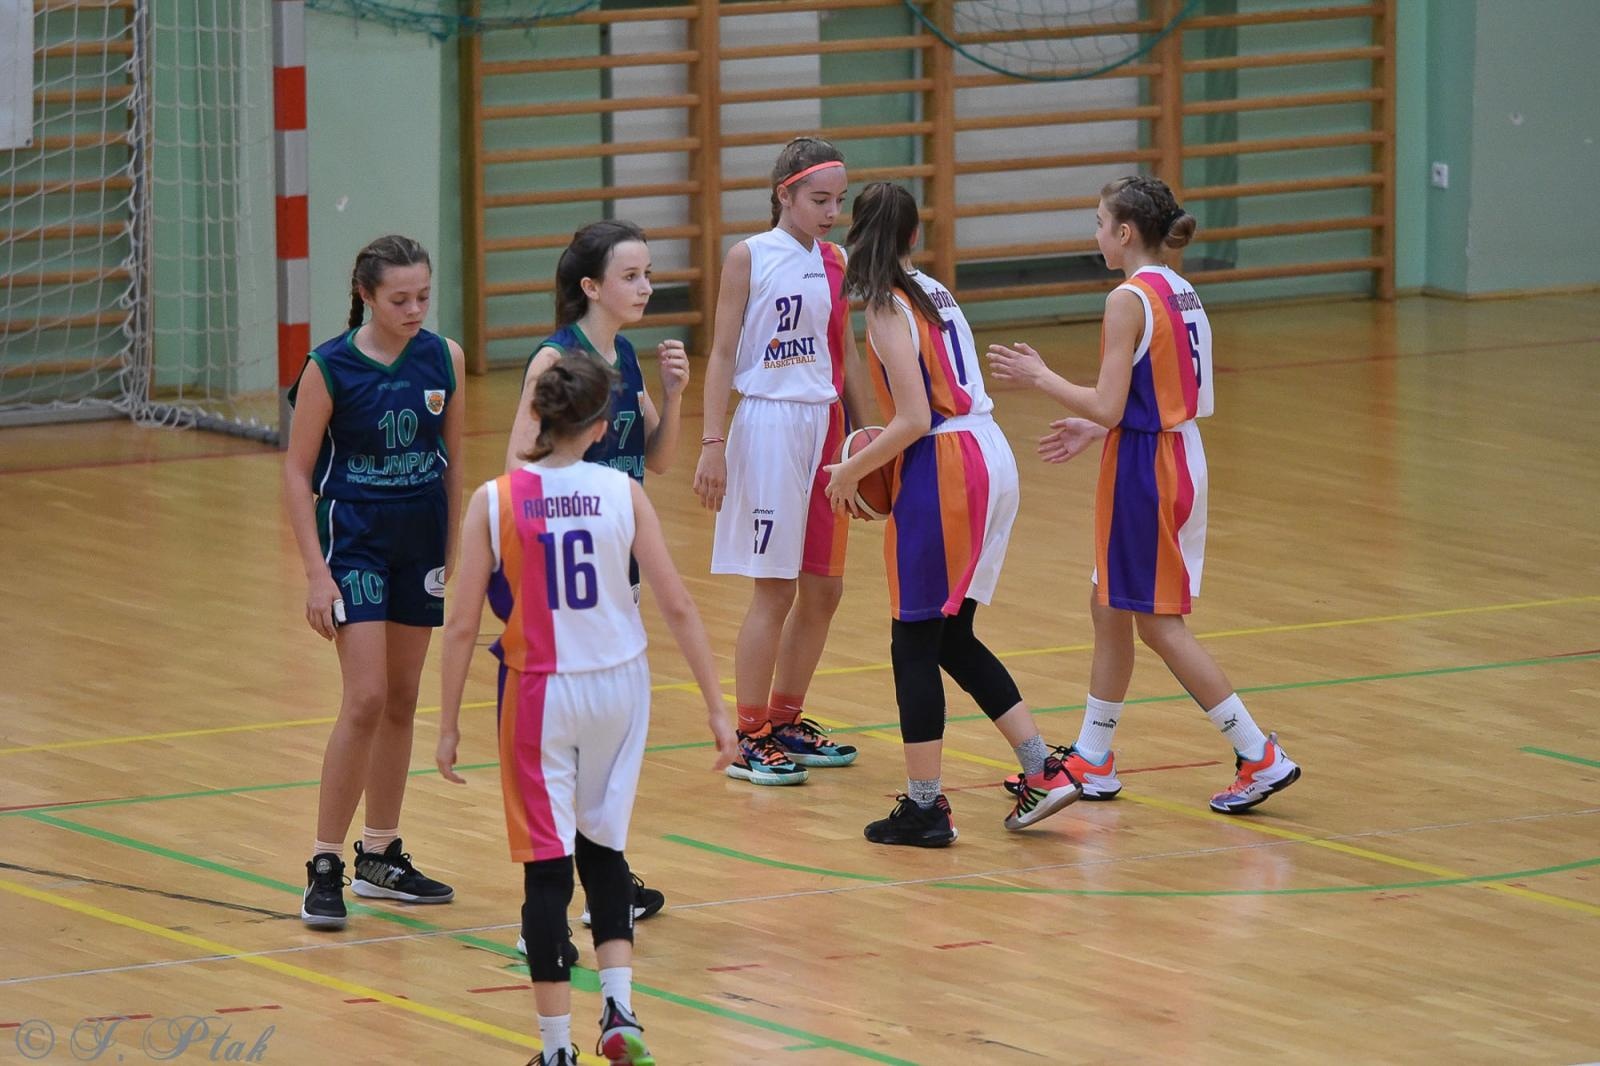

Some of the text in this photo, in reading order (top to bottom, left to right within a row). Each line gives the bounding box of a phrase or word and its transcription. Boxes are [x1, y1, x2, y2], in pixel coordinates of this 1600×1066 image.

[775, 294, 803, 333] 27
[763, 337, 816, 361] MINI
[763, 355, 816, 369] BASKETBALL
[943, 319, 968, 386] 1
[378, 408, 418, 449] 10
[524, 490, 602, 519] RACIBÓRZ
[341, 569, 385, 605] 10
[537, 529, 599, 611] 16
